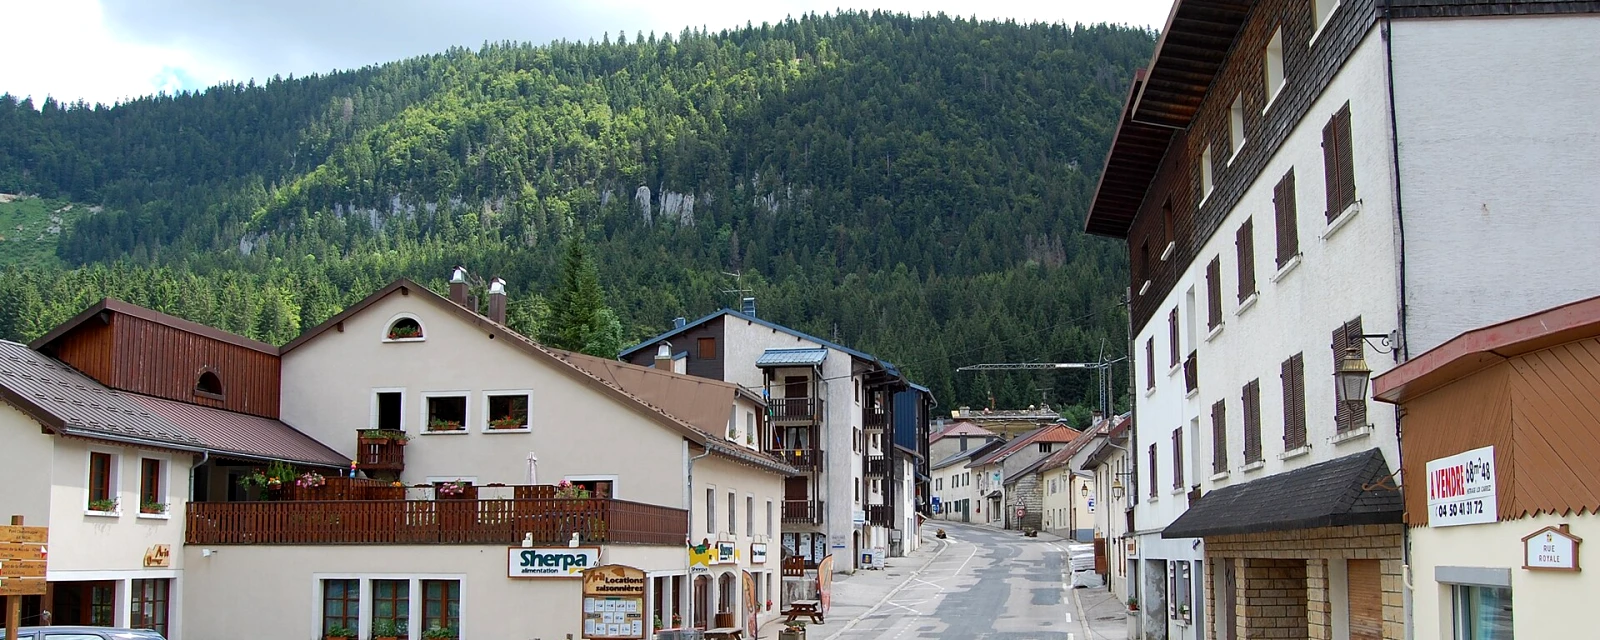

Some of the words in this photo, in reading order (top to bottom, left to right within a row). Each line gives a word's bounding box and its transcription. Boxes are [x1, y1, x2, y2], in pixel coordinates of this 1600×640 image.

[1430, 471, 1436, 500] A
[1436, 465, 1465, 499] VENDRE
[1438, 504, 1447, 518] 04
[1449, 503, 1458, 517] 50
[1459, 502, 1466, 516] 41
[1466, 501, 1473, 515] 31
[1473, 499, 1483, 514] 72
[1543, 545, 1555, 553] RUE
[520, 550, 587, 570] Sherpa
[1538, 555, 1560, 563] ROYALE
